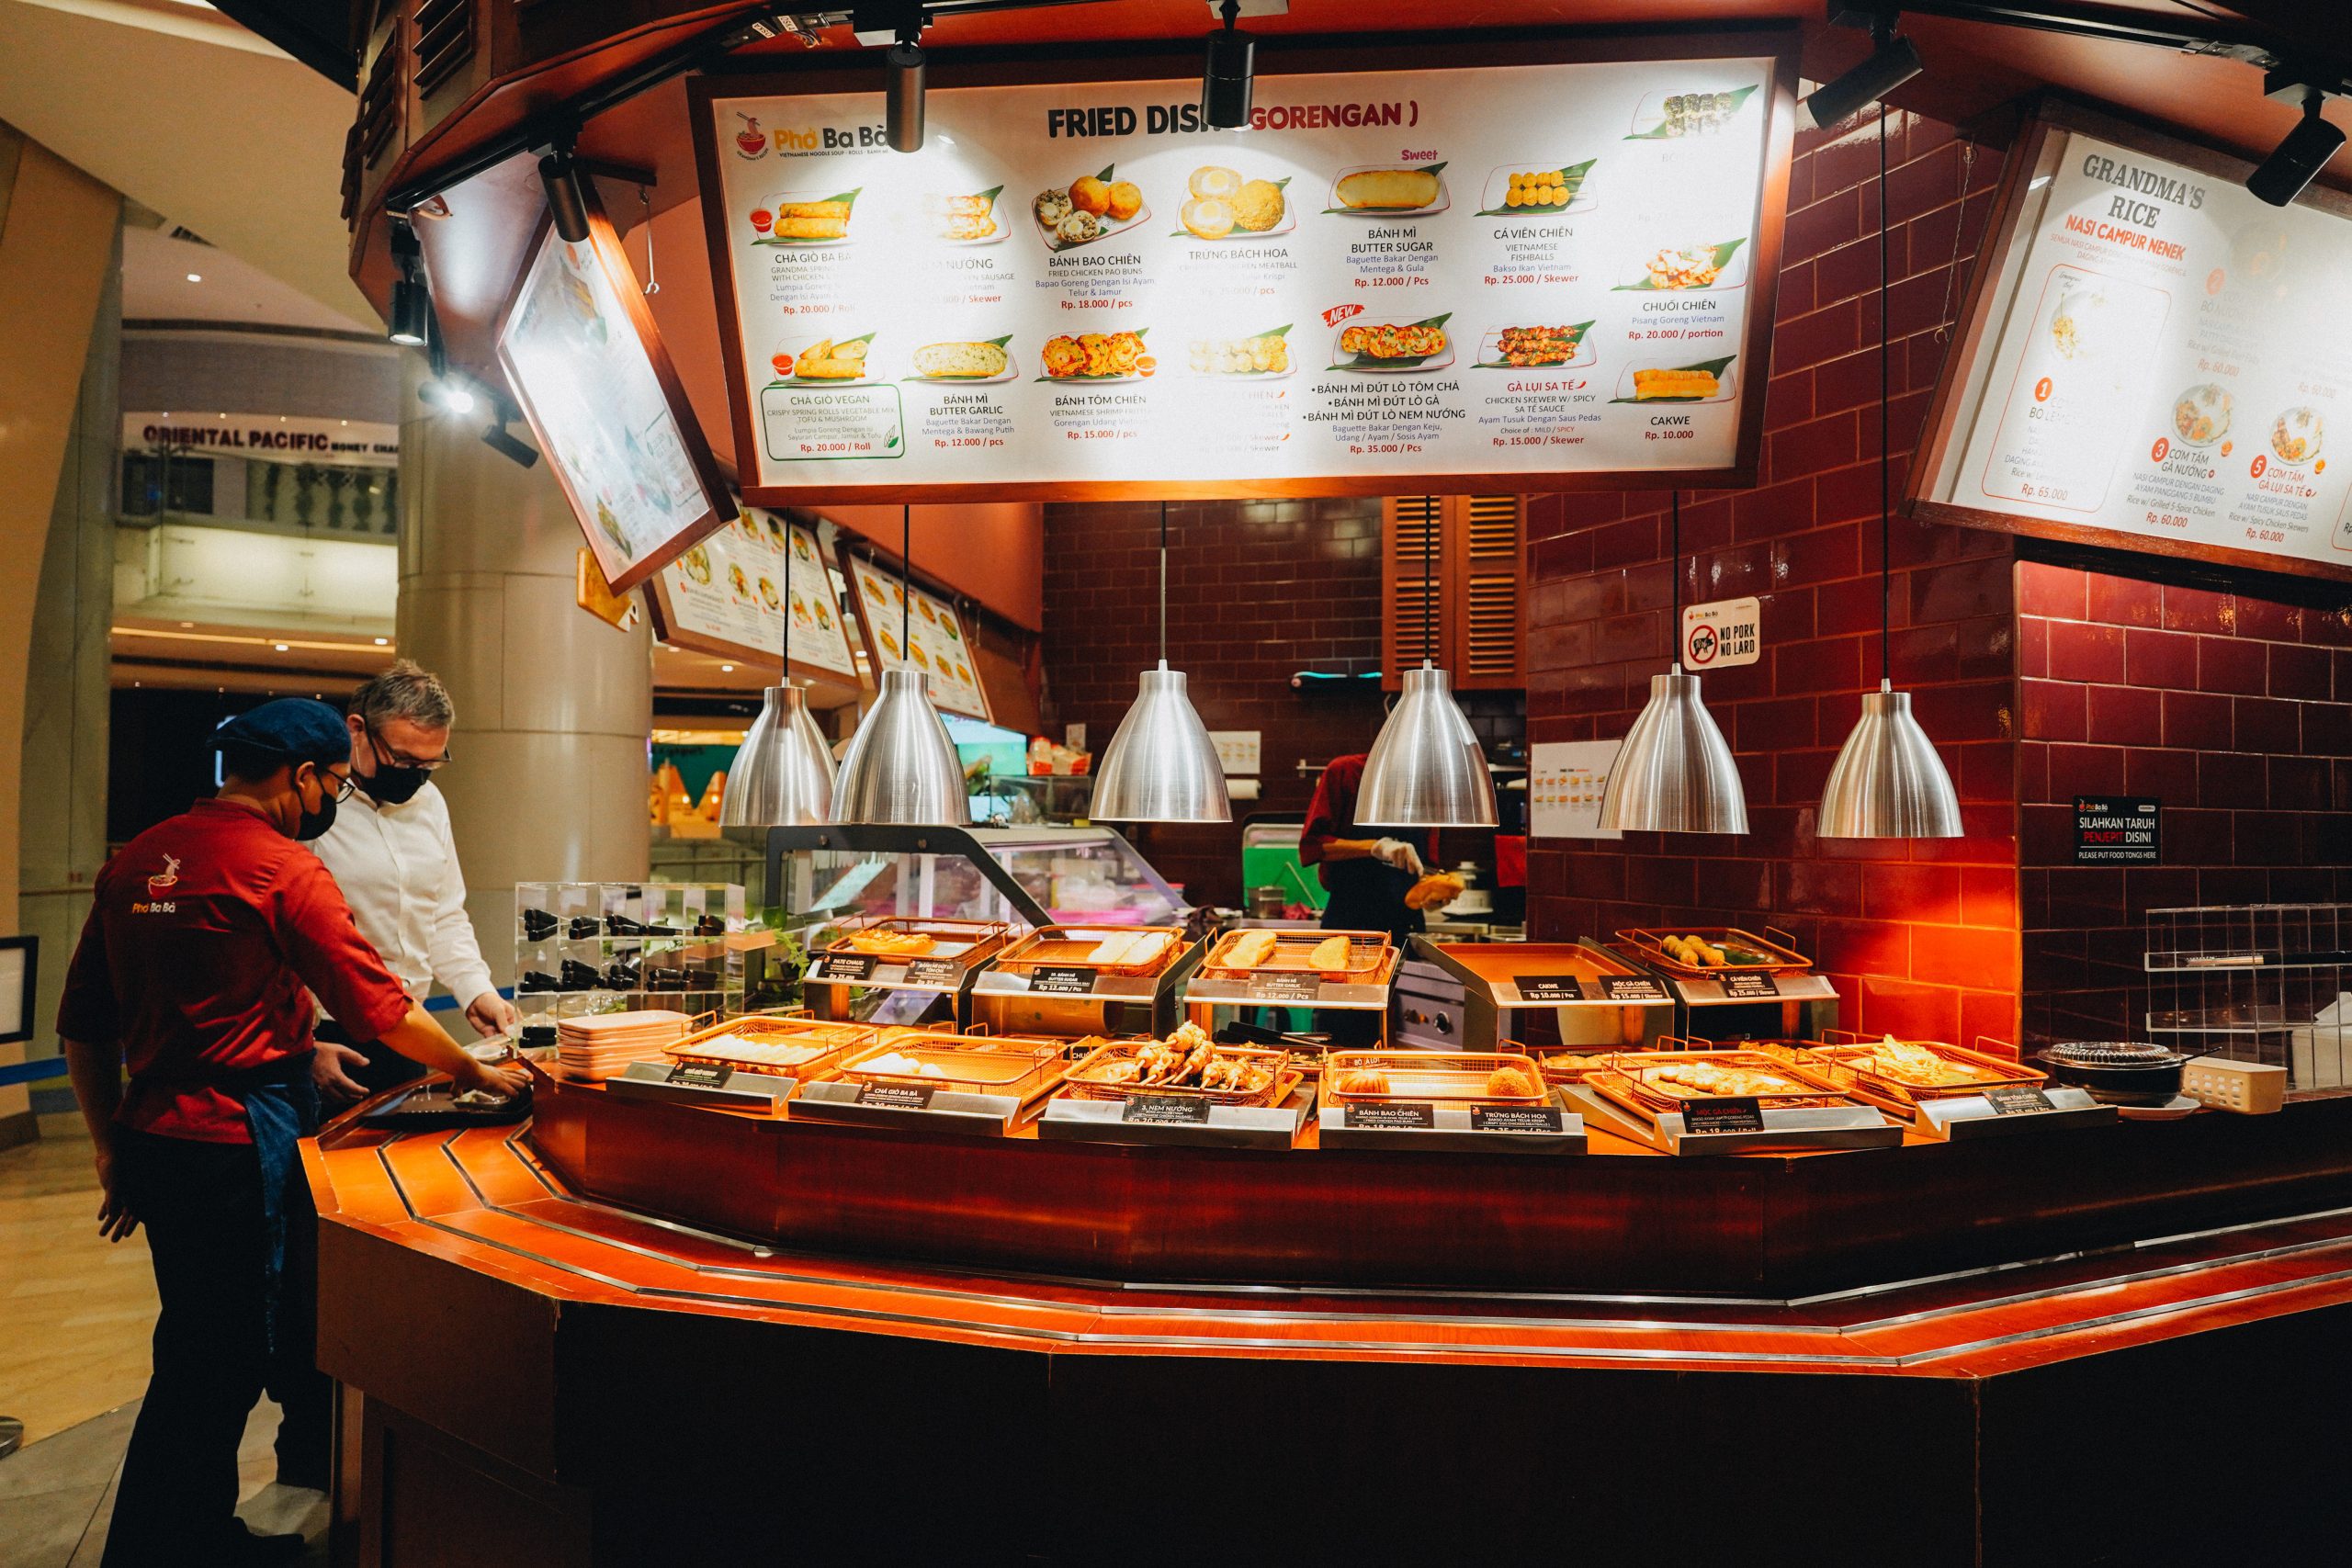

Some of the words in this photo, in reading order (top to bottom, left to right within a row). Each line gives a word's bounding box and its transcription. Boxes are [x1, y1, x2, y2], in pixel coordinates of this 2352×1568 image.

[1048, 107, 1136, 138] FRIED
[823, 128, 854, 148] Ba
[859, 125, 888, 146] Bà
[1402, 150, 1438, 160] Sweet
[2083, 154, 2205, 209] GRANDMA'S
[2108, 196, 2161, 229] RICE
[1369, 228, 1399, 239] BÁNH
[1404, 226, 1416, 237] MÌ
[1494, 228, 1509, 239] CÁ
[1511, 227, 1535, 238] VIÊN
[1539, 226, 1573, 238] CHIÊN
[2065, 214, 2097, 235] NASI
[2098, 224, 2147, 250] CAMPUR
[2148, 238, 2187, 261] NENEK
[1264, 249, 1288, 257] HOA
[1351, 243, 1393, 253] BUTTER
[1396, 243, 1432, 252] SUGAR
[1506, 243, 1558, 252] VIETNAMESE
[1049, 255, 1080, 266] BÁNH
[1082, 256, 1105, 265] BAO
[1108, 254, 1140, 265] CHIÊN
[1354, 279, 1369, 288] Rp.
[1374, 277, 1404, 286] 12.000
[1485, 276, 1499, 286] Rp.
[1503, 276, 1533, 284] 25.000
[969, 295, 1001, 303] Skewer
[1062, 300, 1075, 310] Rp.
[1118, 299, 1132, 309] pcs
[1682, 299, 1716, 310] CHIÊN
[1330, 304, 1355, 324] NEW
[1629, 331, 1643, 340] Rp.
[1646, 331, 1678, 339] 20.000
[1689, 329, 1723, 339] portion
[1317, 384, 1347, 393] BÁNH
[1351, 383, 1363, 393] MÌ
[1367, 382, 1389, 392] ĐÚT
[1393, 382, 1406, 391] LÒ
[1409, 382, 1433, 391] TÔM
[1508, 381, 1522, 391] GÀ
[1545, 382, 1558, 390] SA
[835, 395, 869, 403] VEGAN
[944, 394, 972, 404] BÁNH
[976, 393, 988, 403] MÌ
[1056, 395, 1084, 406] BÁNH
[1088, 394, 1112, 404] TÔM
[1335, 397, 1363, 407] BÁNH
[1368, 397, 1380, 406] MÌ
[1384, 395, 1406, 406] ĐÚT
[1409, 396, 1422, 405] LÒ
[1426, 394, 1440, 405] GÀ
[1523, 396, 1556, 404] SKEWER
[930, 407, 966, 415] BUTTER
[969, 406, 1002, 414] GARLIC
[1308, 412, 1338, 421] BÁNH
[1341, 411, 1353, 420] MÌ
[1357, 410, 1379, 420] ĐÚT
[1383, 410, 1396, 419] LÒ
[1399, 411, 1422, 419] NEM
[1651, 416, 1690, 425] CAKWE
[143, 425, 244, 446] ORIENTAL
[249, 431, 328, 450] PACIFIC
[1493, 438, 1507, 446] Rp.
[1511, 437, 1541, 446] 15.000
[1551, 436, 1584, 445] Skewer
[1645, 432, 1659, 441] Rp.
[935, 439, 948, 447] Rp.
[952, 438, 980, 446] 12.000
[990, 438, 1003, 446] pcs
[1351, 446, 1364, 455] Rp.
[1368, 445, 1397, 453] 35.000
[2146, 512, 2158, 525] Rp.
[2161, 516, 2188, 527] 60.000
[2246, 528, 2257, 539] Rp.
[2260, 531, 2284, 542] 60.000
[1721, 627, 1730, 640] NO
[1735, 623, 1755, 638] PORK
[1721, 643, 1731, 656] NO
[1735, 640, 1754, 655] LARD
[2079, 818, 2123, 829] SILAHKAN
[2125, 818, 2154, 829] TARUH
[2084, 831, 2124, 843] PENJEPIT
[2126, 832, 2151, 842] DISINI
[150, 902, 162, 912] Ba
